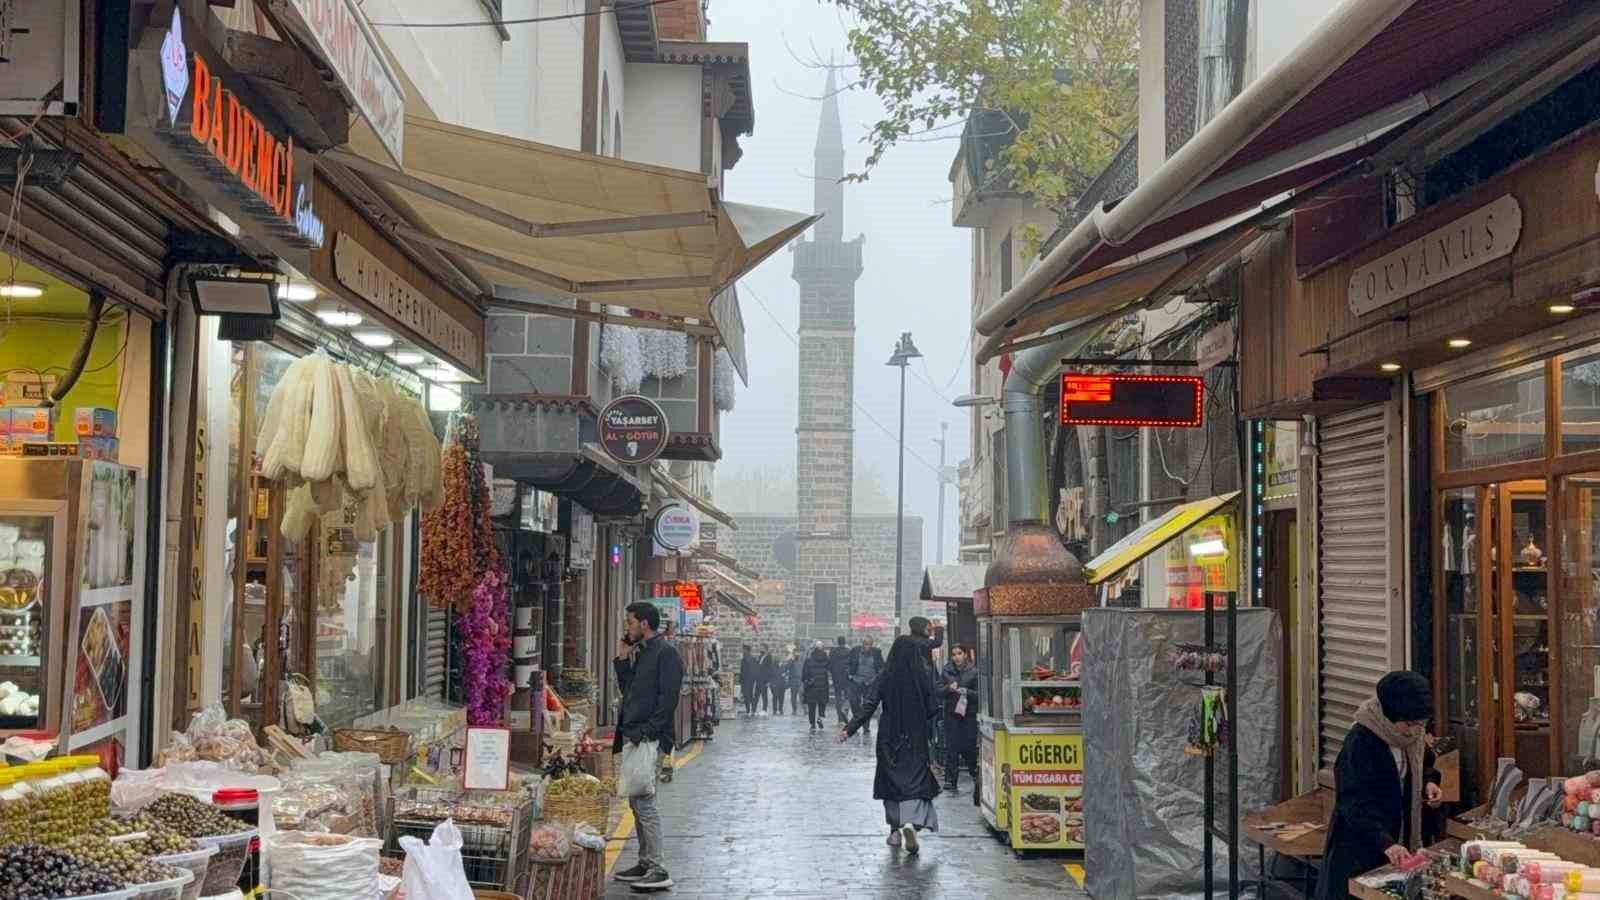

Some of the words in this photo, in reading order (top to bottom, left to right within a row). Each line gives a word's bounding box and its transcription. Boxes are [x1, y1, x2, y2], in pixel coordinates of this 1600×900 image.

[607, 432, 617, 440] AL
[1014, 771, 1032, 784] TÜM
[1035, 773, 1068, 784] IZGARA
[1069, 774, 1083, 787] ÇE
